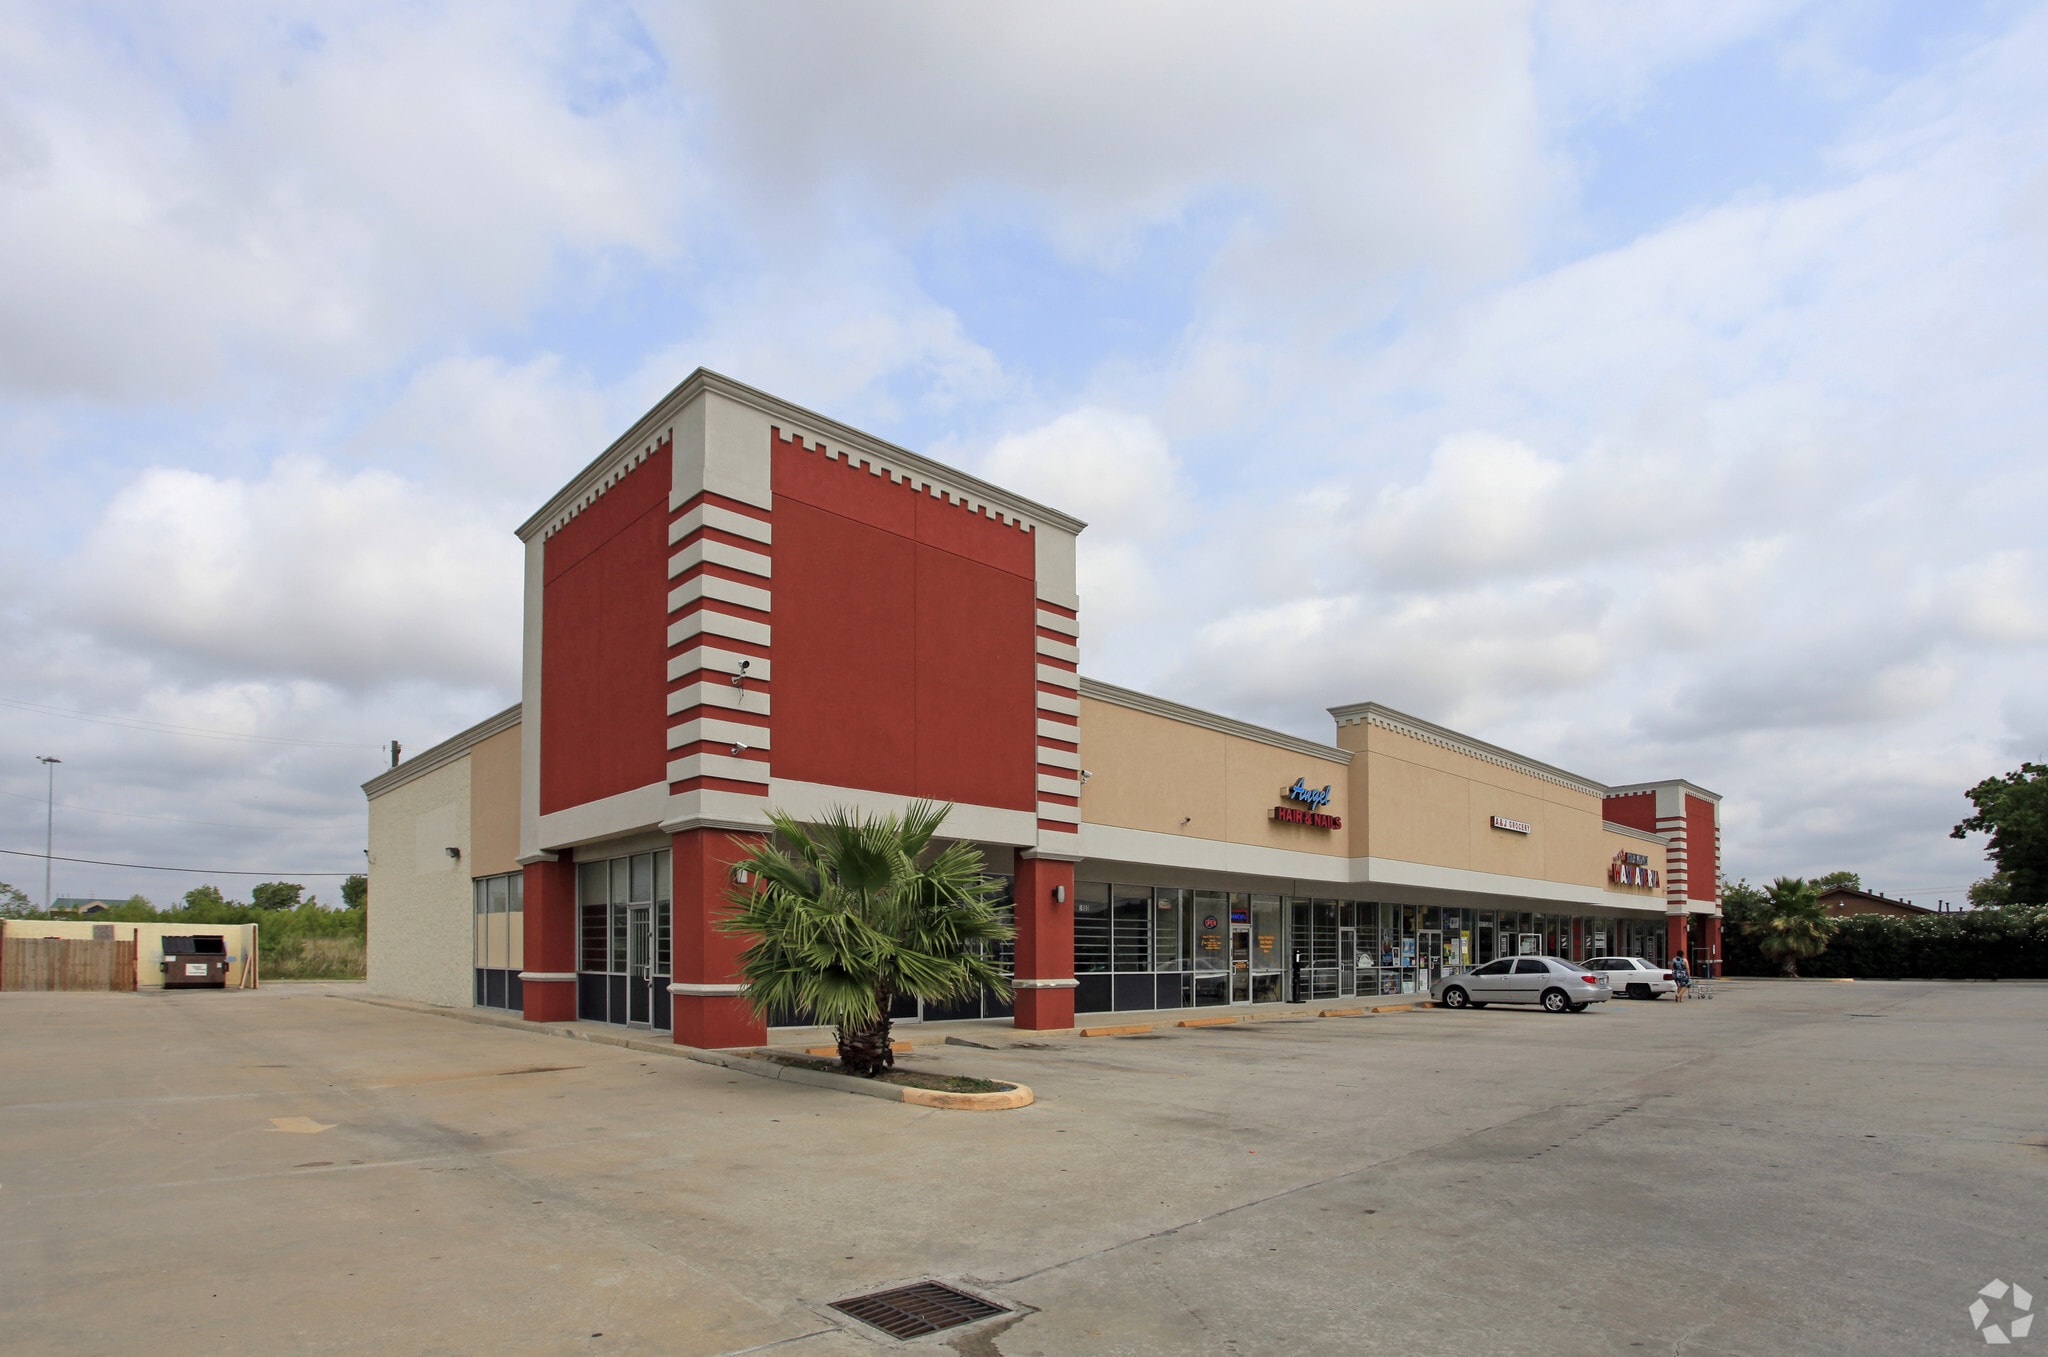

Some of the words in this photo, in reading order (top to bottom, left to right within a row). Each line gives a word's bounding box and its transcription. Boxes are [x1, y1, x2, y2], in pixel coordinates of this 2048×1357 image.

[1289, 777, 1331, 811] Angel
[1278, 807, 1303, 823] HAIR
[1305, 811, 1313, 825] &
[1314, 813, 1342, 829] NAILS
[1508, 820, 1530, 832] GROCERY
[1204, 918, 1217, 927] OPEN
